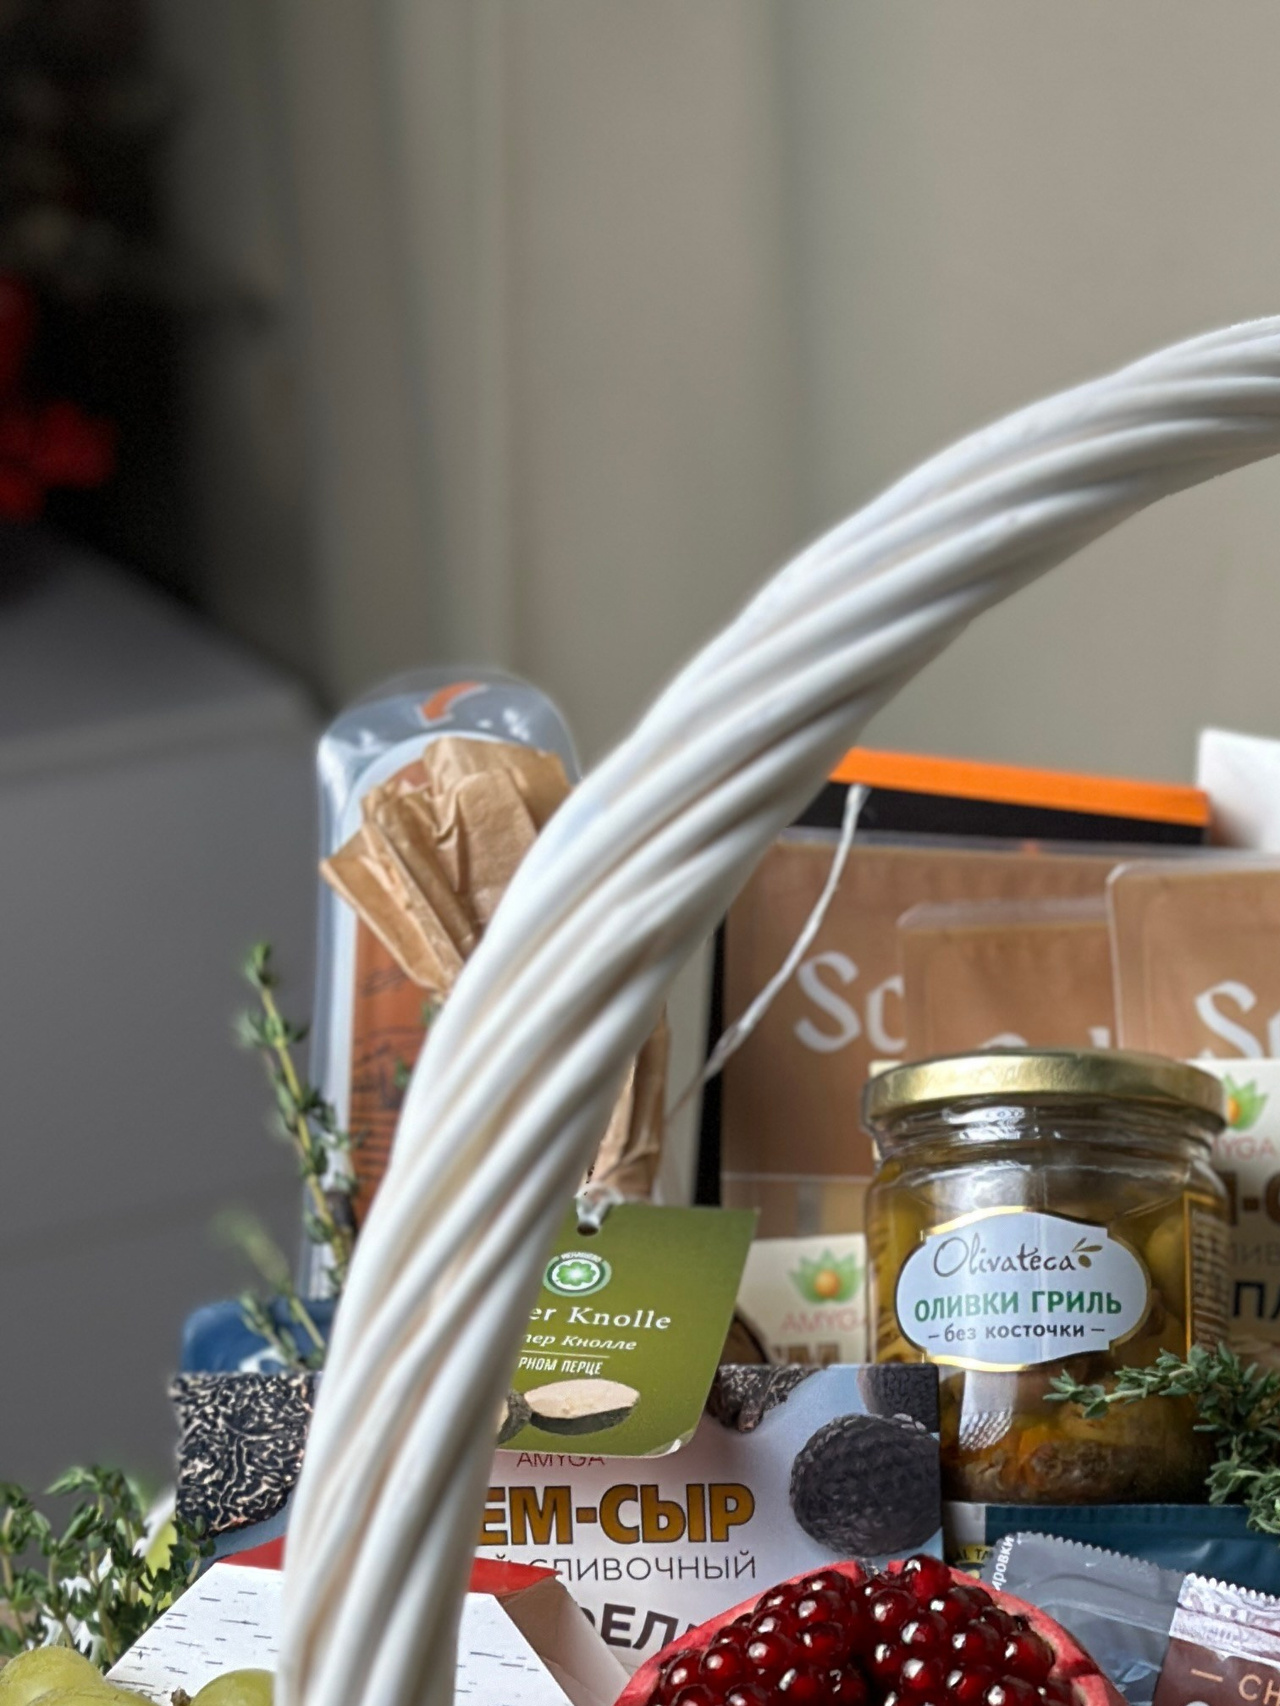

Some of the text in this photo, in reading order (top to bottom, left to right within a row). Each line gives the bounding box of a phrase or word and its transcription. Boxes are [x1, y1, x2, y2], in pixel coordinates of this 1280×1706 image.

[933, 1232, 1077, 1278] Olivateca
[567, 1305, 672, 1330] Knolle
[914, 1290, 1122, 1323] ОЛИВКИ ГРИЛЬ
[560, 1335, 638, 1351] Кнолле
[944, 1324, 1086, 1343] без косточки
[560, 1360, 604, 1376] ПЕРЦЕ
